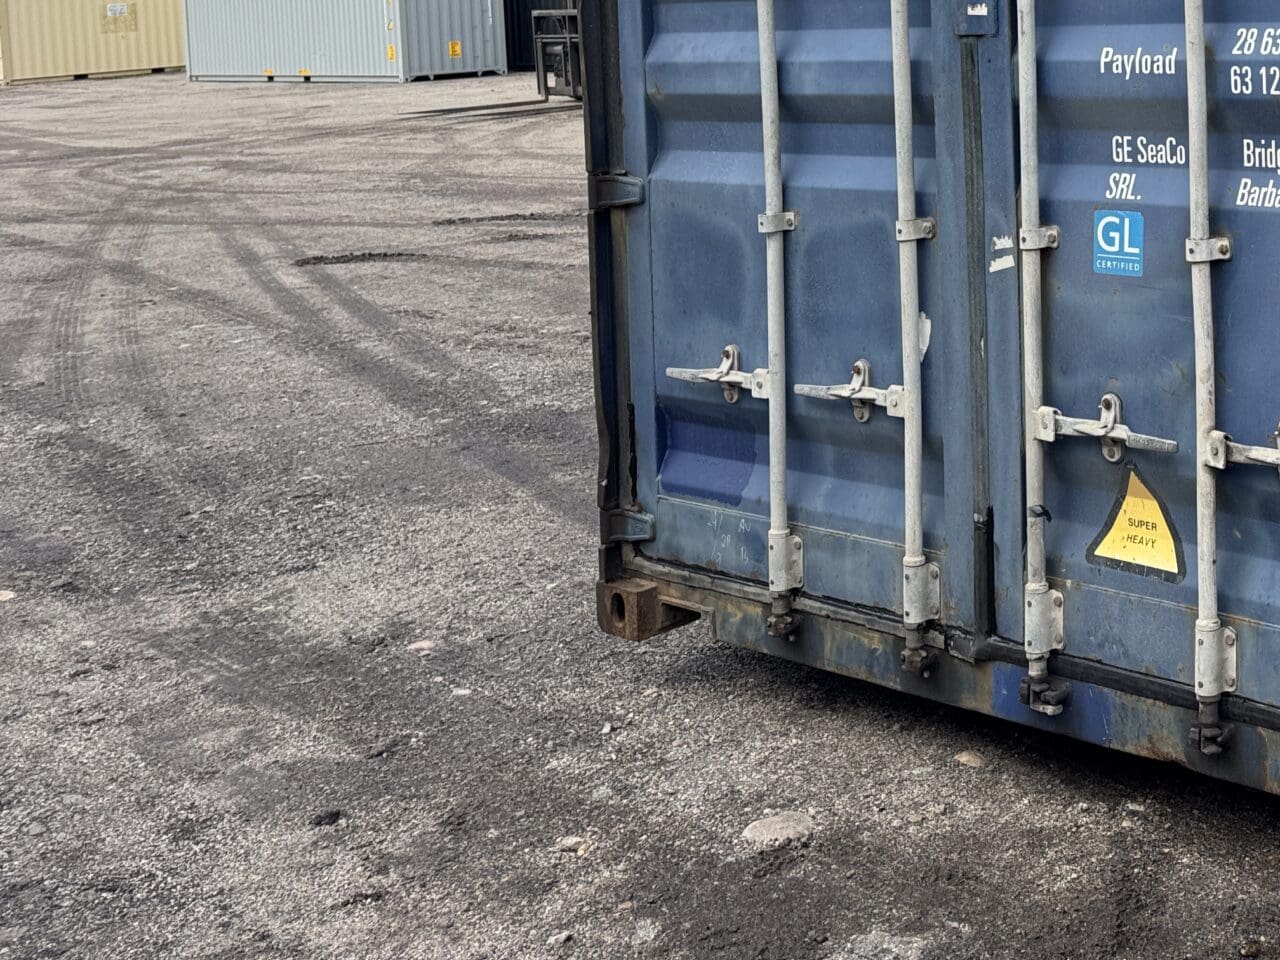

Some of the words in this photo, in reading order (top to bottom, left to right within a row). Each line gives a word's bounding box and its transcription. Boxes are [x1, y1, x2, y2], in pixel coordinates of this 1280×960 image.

[1232, 28, 1258, 55] 28
[1100, 48, 1177, 80] Payload
[1230, 66, 1252, 94] 63
[1112, 136, 1132, 163] GE
[1137, 136, 1186, 164] SeaCo
[1106, 173, 1141, 200] SRL.
[1097, 216, 1140, 254] GL
[1096, 260, 1140, 272] CERTIFIED
[1128, 518, 1158, 531] SUPER
[1126, 534, 1156, 548] HEAVY
